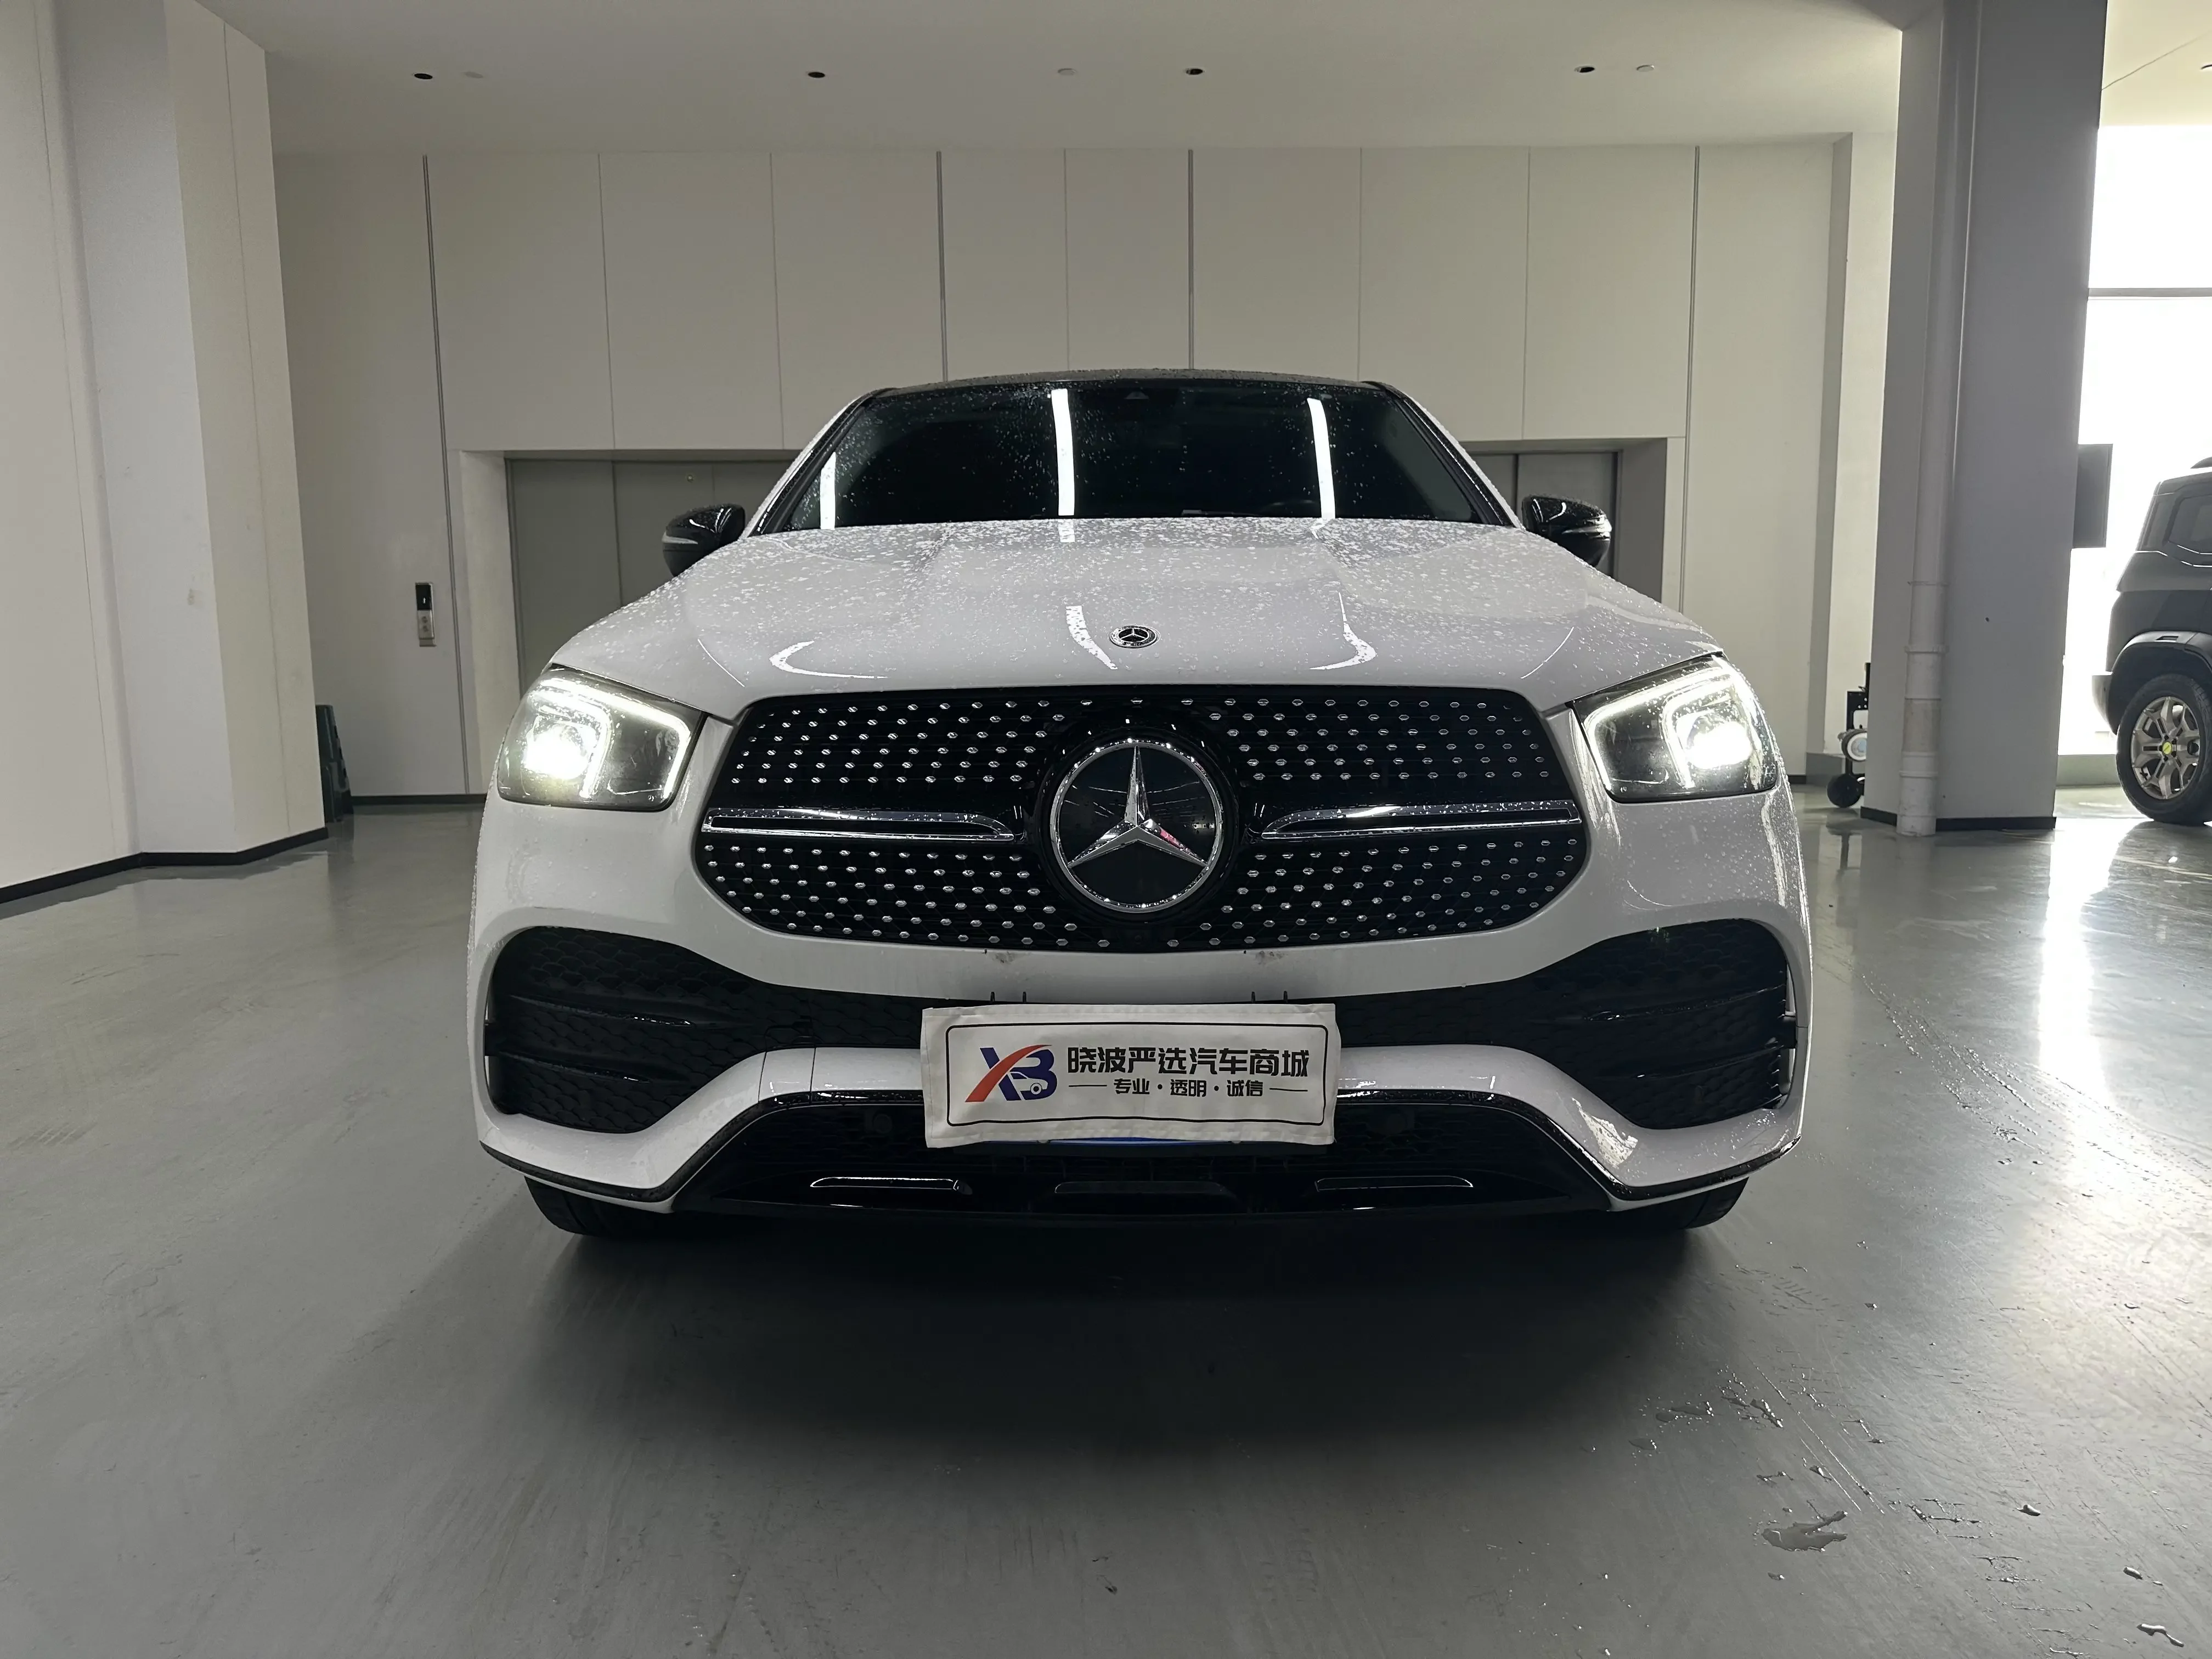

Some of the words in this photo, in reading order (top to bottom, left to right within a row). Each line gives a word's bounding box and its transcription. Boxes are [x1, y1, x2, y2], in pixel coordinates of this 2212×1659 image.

[1068, 1047, 1310, 1077] 晓波严选汽车商城
